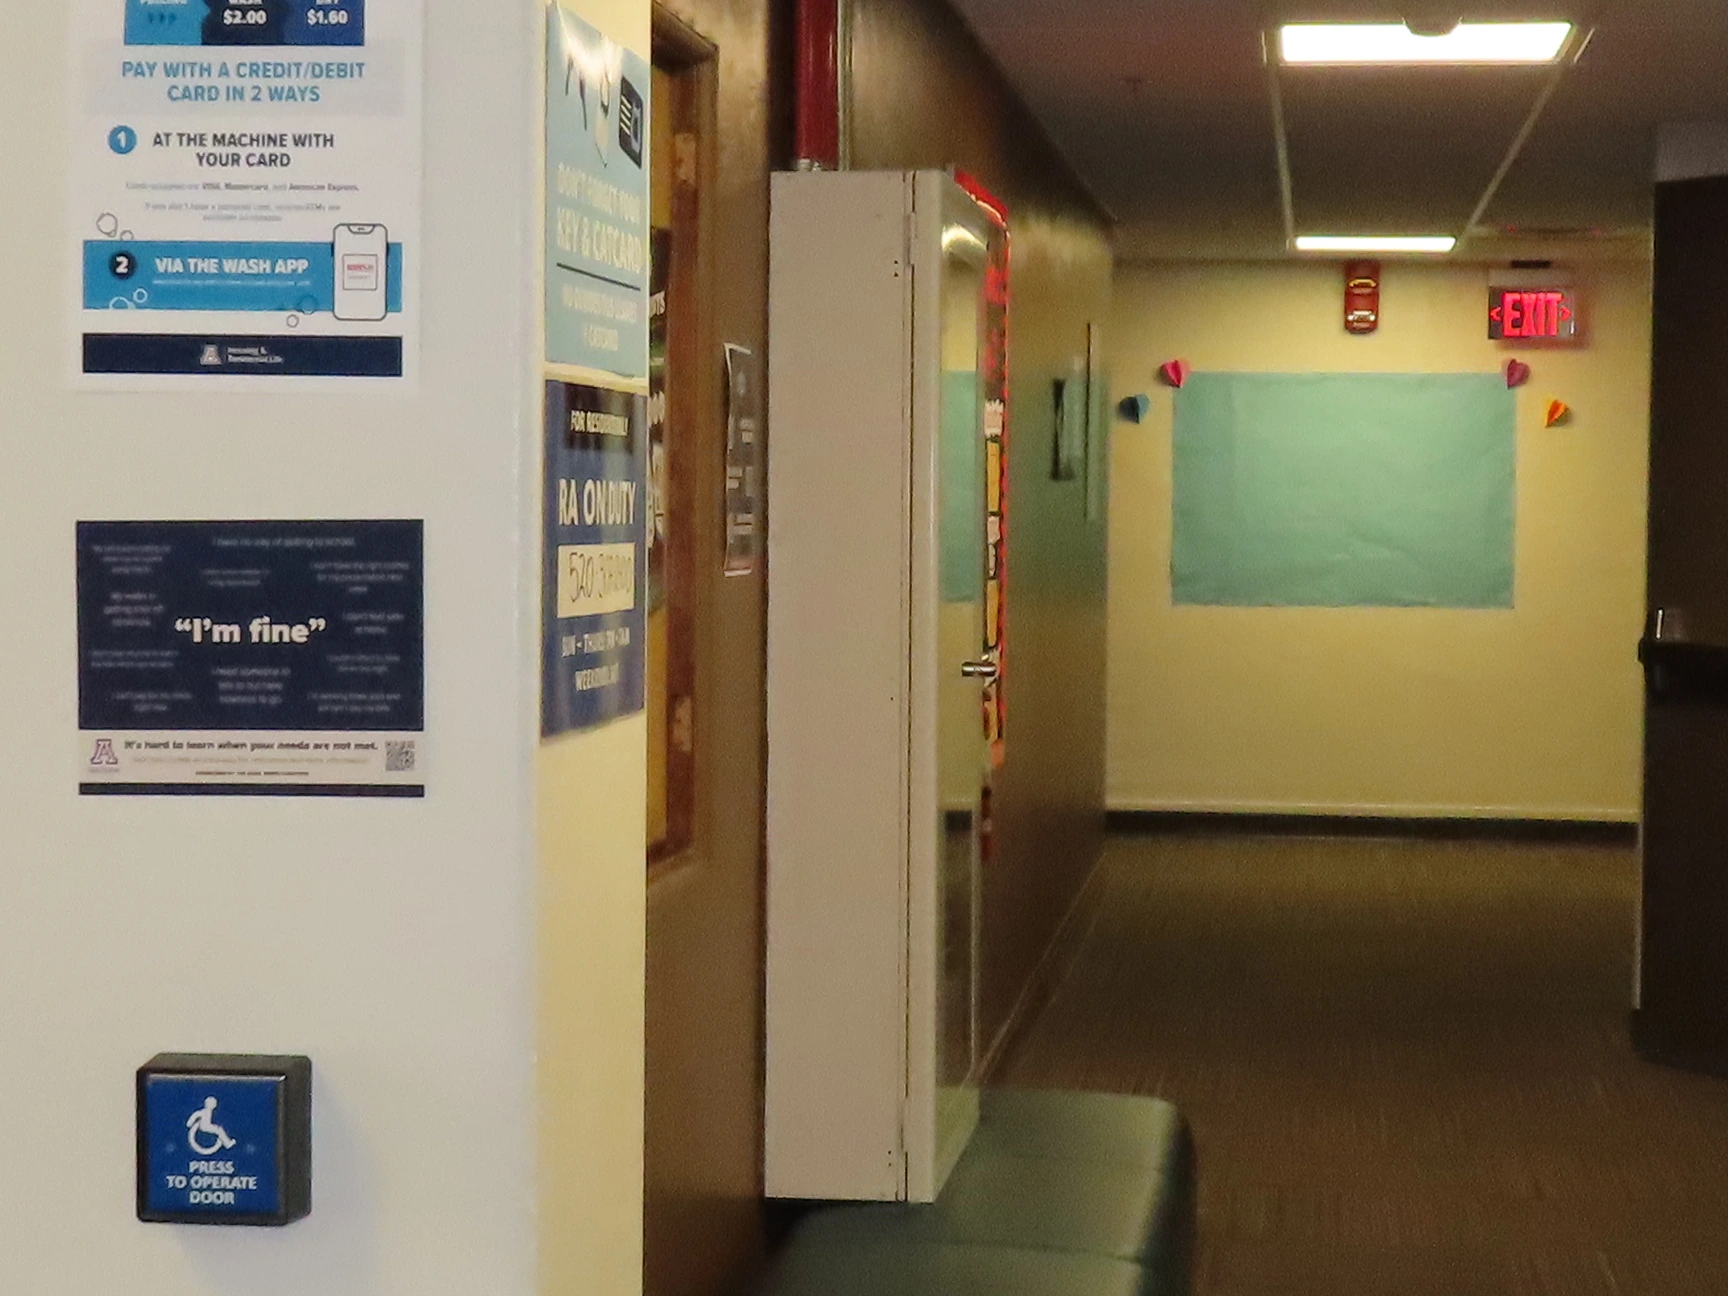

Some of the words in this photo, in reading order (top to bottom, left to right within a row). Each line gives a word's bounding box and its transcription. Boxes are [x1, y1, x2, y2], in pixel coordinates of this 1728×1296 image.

[223, 8, 268, 26] $2.00
[306, 8, 349, 26] $1.60
[122, 61, 158, 78] PAY
[163, 61, 212, 78] WITH
[218, 62, 231, 78] A
[236, 61, 365, 79] CREDIT/DEBIT
[167, 85, 220, 102] CARD
[225, 85, 244, 102] IN
[250, 85, 262, 102] 2
[268, 85, 321, 102] WAYS
[152, 133, 174, 148] AT
[178, 132, 208, 148] THE
[211, 132, 288, 148] MACHINE
[292, 133, 335, 148] WITH
[195, 151, 241, 169] YOUR
[245, 151, 292, 169] CARD
[557, 205, 580, 253] KEY
[115, 256, 129, 274] 2
[154, 257, 184, 274] VIA
[187, 258, 219, 274] THE
[223, 258, 271, 274] WASH
[274, 258, 310, 275] APP
[1501, 289, 1565, 337] EXIT
[558, 478, 579, 526] RA
[582, 478, 607, 526] ON
[607, 480, 636, 525] DUTY
[90, 738, 119, 765] A
[188, 1160, 235, 1174] PRESS
[166, 1175, 187, 1189] TO
[190, 1175, 258, 1190] OPERATE
[189, 1191, 235, 1205] DOOR
